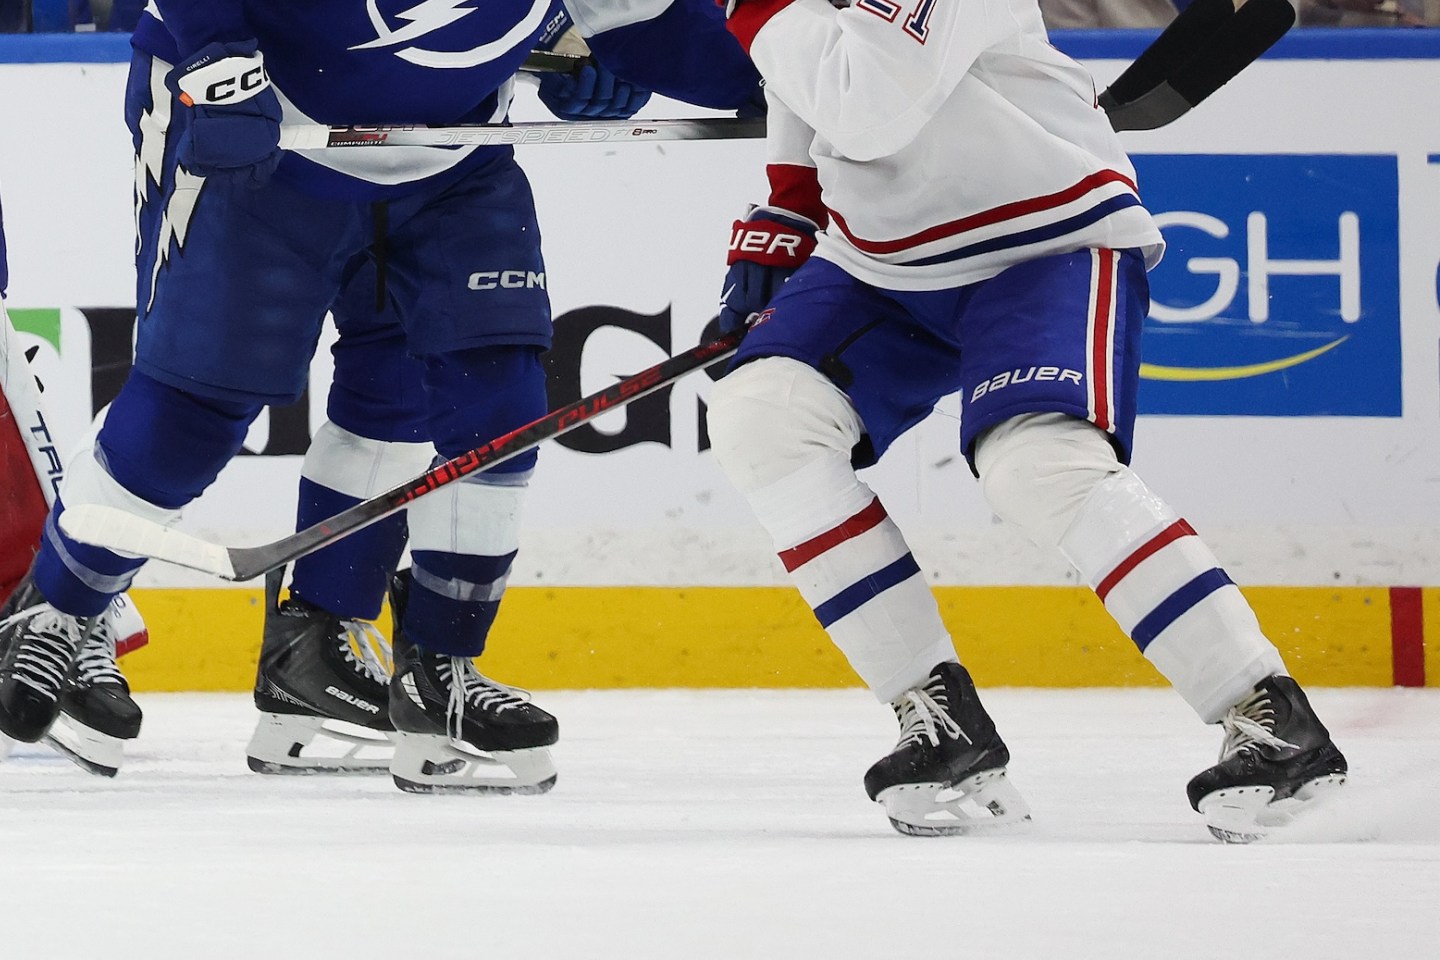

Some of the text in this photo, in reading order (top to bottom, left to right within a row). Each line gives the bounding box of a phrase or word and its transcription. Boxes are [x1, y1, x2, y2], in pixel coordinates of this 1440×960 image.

[186, 55, 210, 72] CIRELLI
[205, 65, 269, 103] CC
[434, 128, 610, 146] JETSPEED
[466, 270, 546, 291] CCM
[969, 366, 1085, 404] BAUER
[324, 684, 381, 716] BAUER
